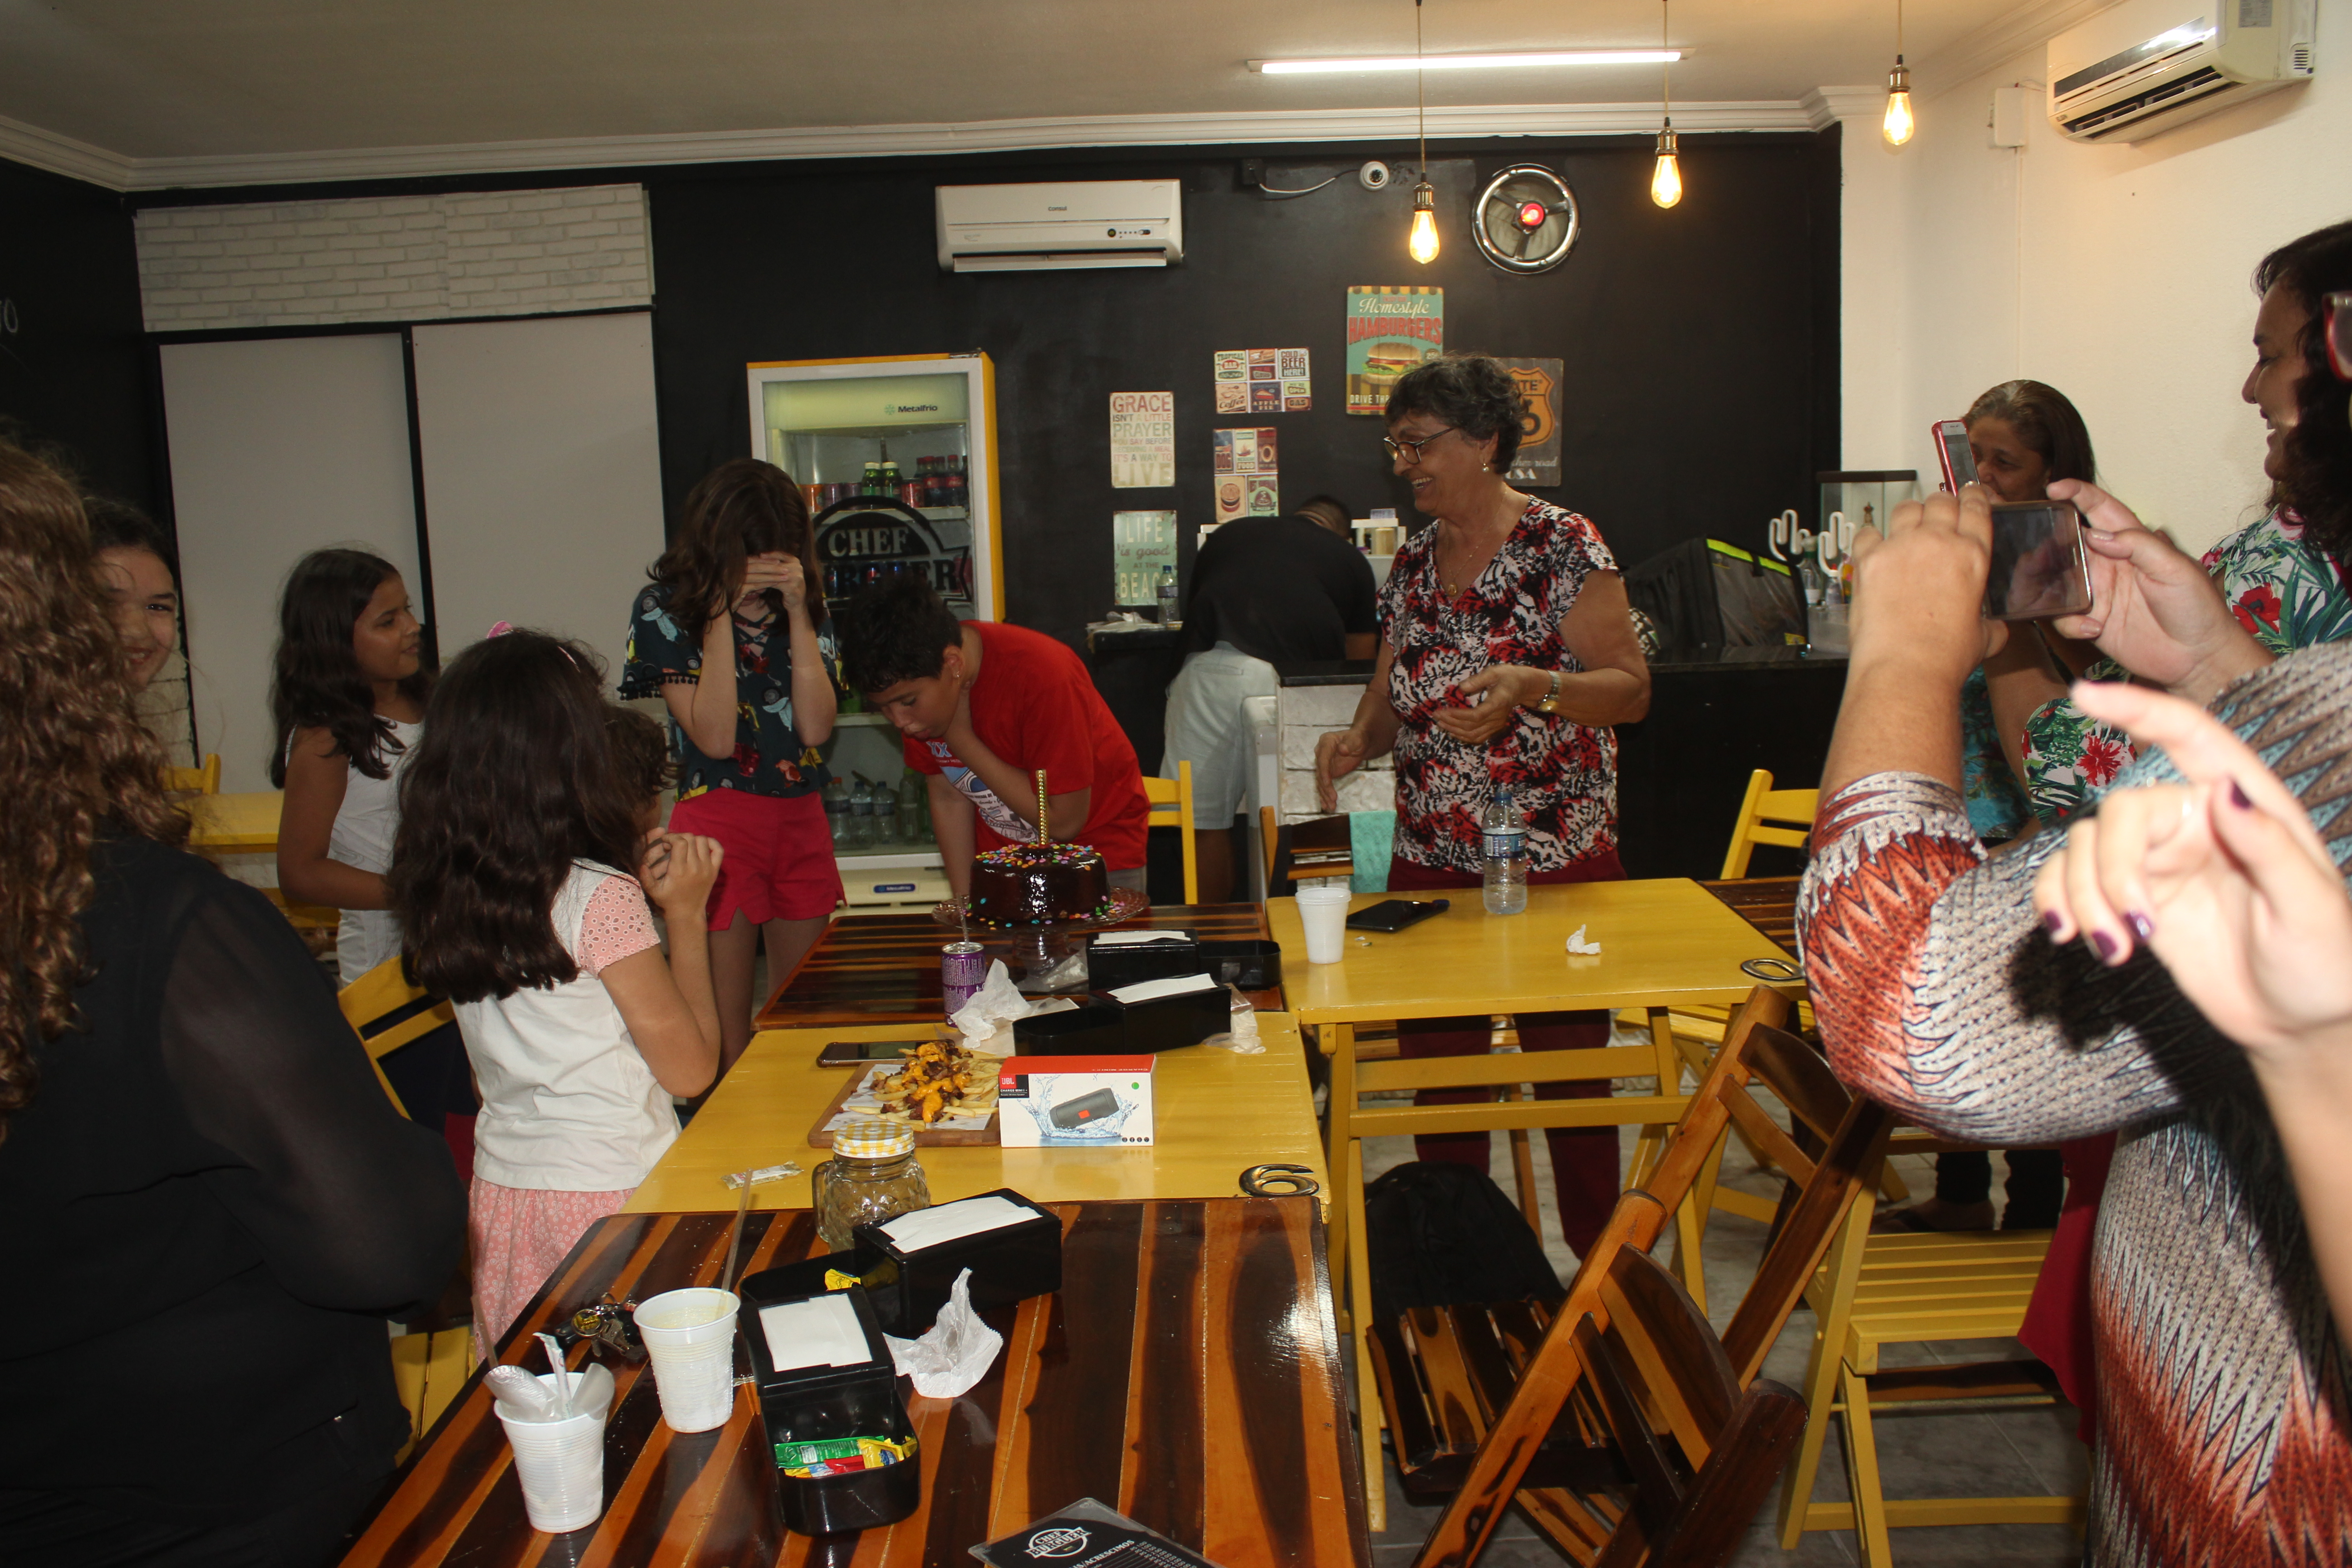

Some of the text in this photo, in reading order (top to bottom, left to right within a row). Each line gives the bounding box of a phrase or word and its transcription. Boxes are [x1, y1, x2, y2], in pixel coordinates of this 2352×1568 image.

[1359, 297, 1430, 318] Homestyle
[1348, 315, 1442, 345] HAMBURGERS
[1282, 358, 1305, 368] BEER
[1112, 394, 1171, 412] GRACE
[1219, 398, 1246, 409] Coffee
[1349, 394, 1391, 404] DRIVE THR
[898, 404, 938, 413] Metalfrio
[1112, 414, 1134, 422] ISN'T
[1144, 413, 1171, 421] LITTLE
[1112, 422, 1172, 437] PRAYER
[1113, 454, 1128, 462] IT'S
[1131, 454, 1137, 462] A
[1140, 454, 1158, 462] WAY
[1112, 463, 1172, 486] LIVE
[1126, 517, 1164, 543] LIFE
[827, 525, 910, 558] CHEF
[1120, 544, 1171, 560] is good
[1120, 571, 1160, 598] BEAC
[1001, 1077, 1015, 1085] JBL
[1029, 1529, 1087, 1556] BURGUER
[1035, 1530, 1062, 1545] CHEF
[1069, 1539, 1135, 1568] IS/ACRESCIMOS
